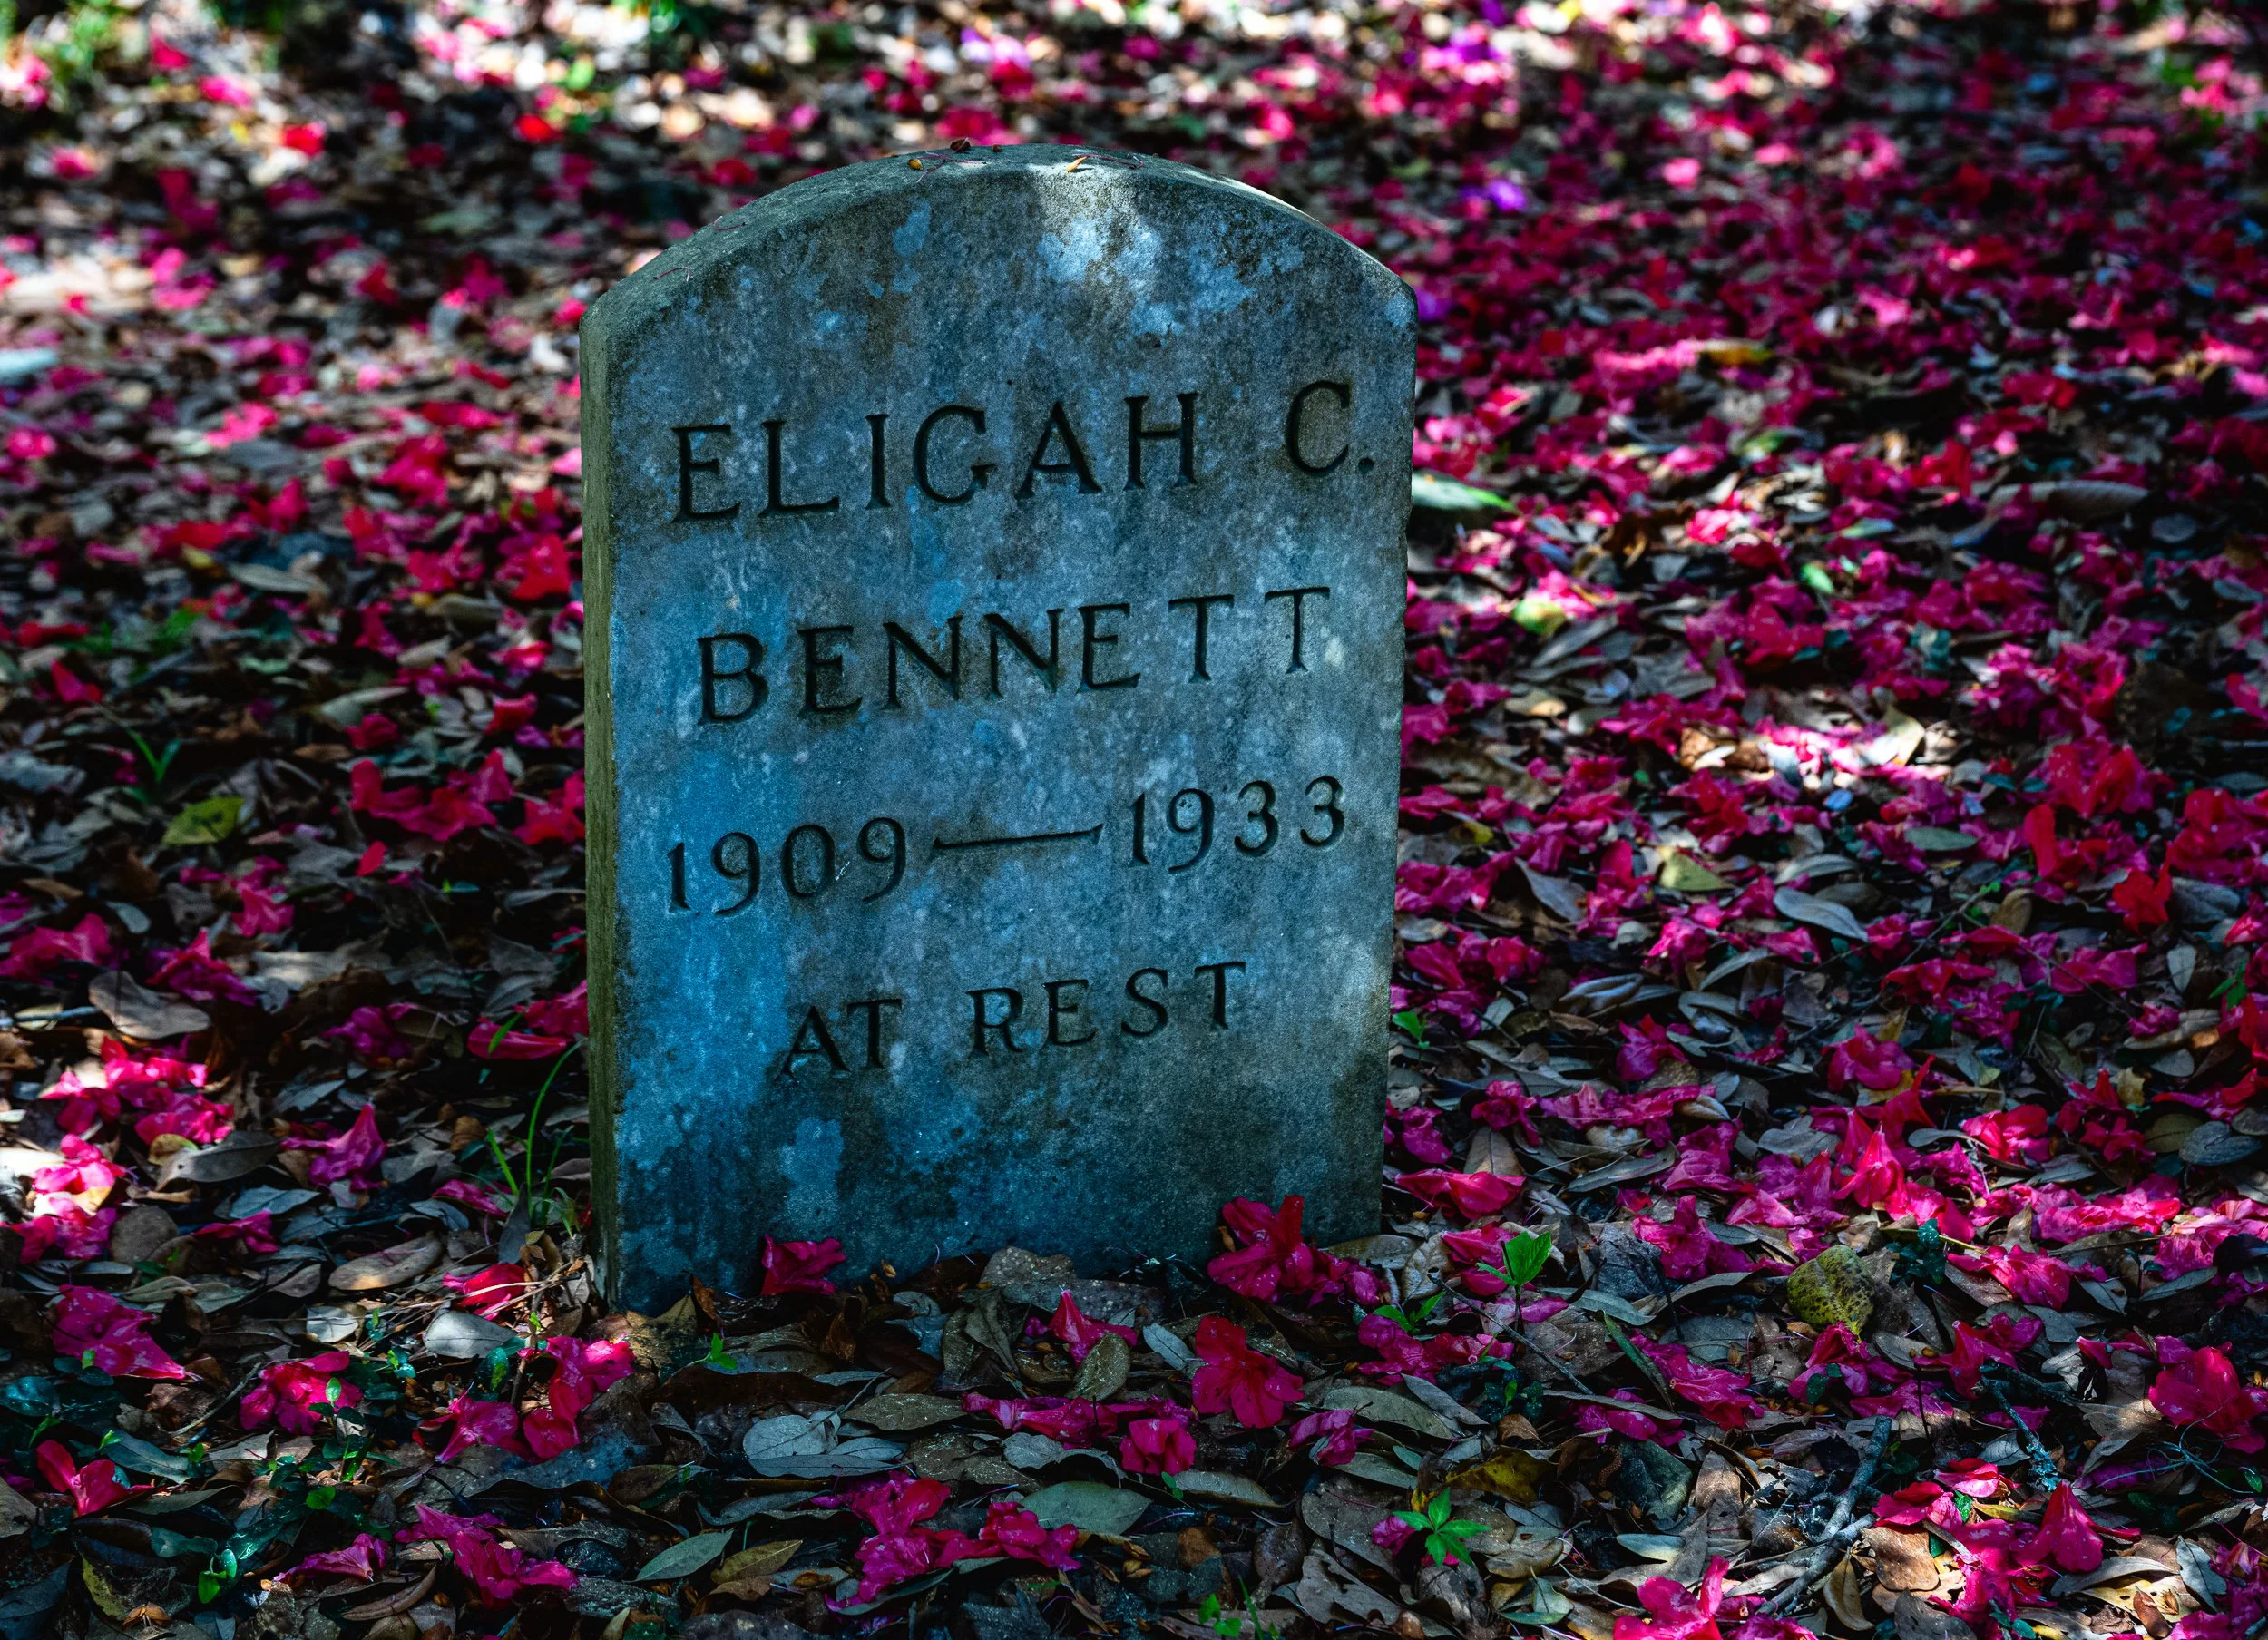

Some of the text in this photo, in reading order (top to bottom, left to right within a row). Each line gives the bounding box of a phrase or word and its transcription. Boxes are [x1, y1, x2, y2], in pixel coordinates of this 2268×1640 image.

[671, 379, 1376, 524] ELIGAH C.
[696, 586, 1332, 727] BENNETT
[773, 961, 1247, 1085] AT REST
